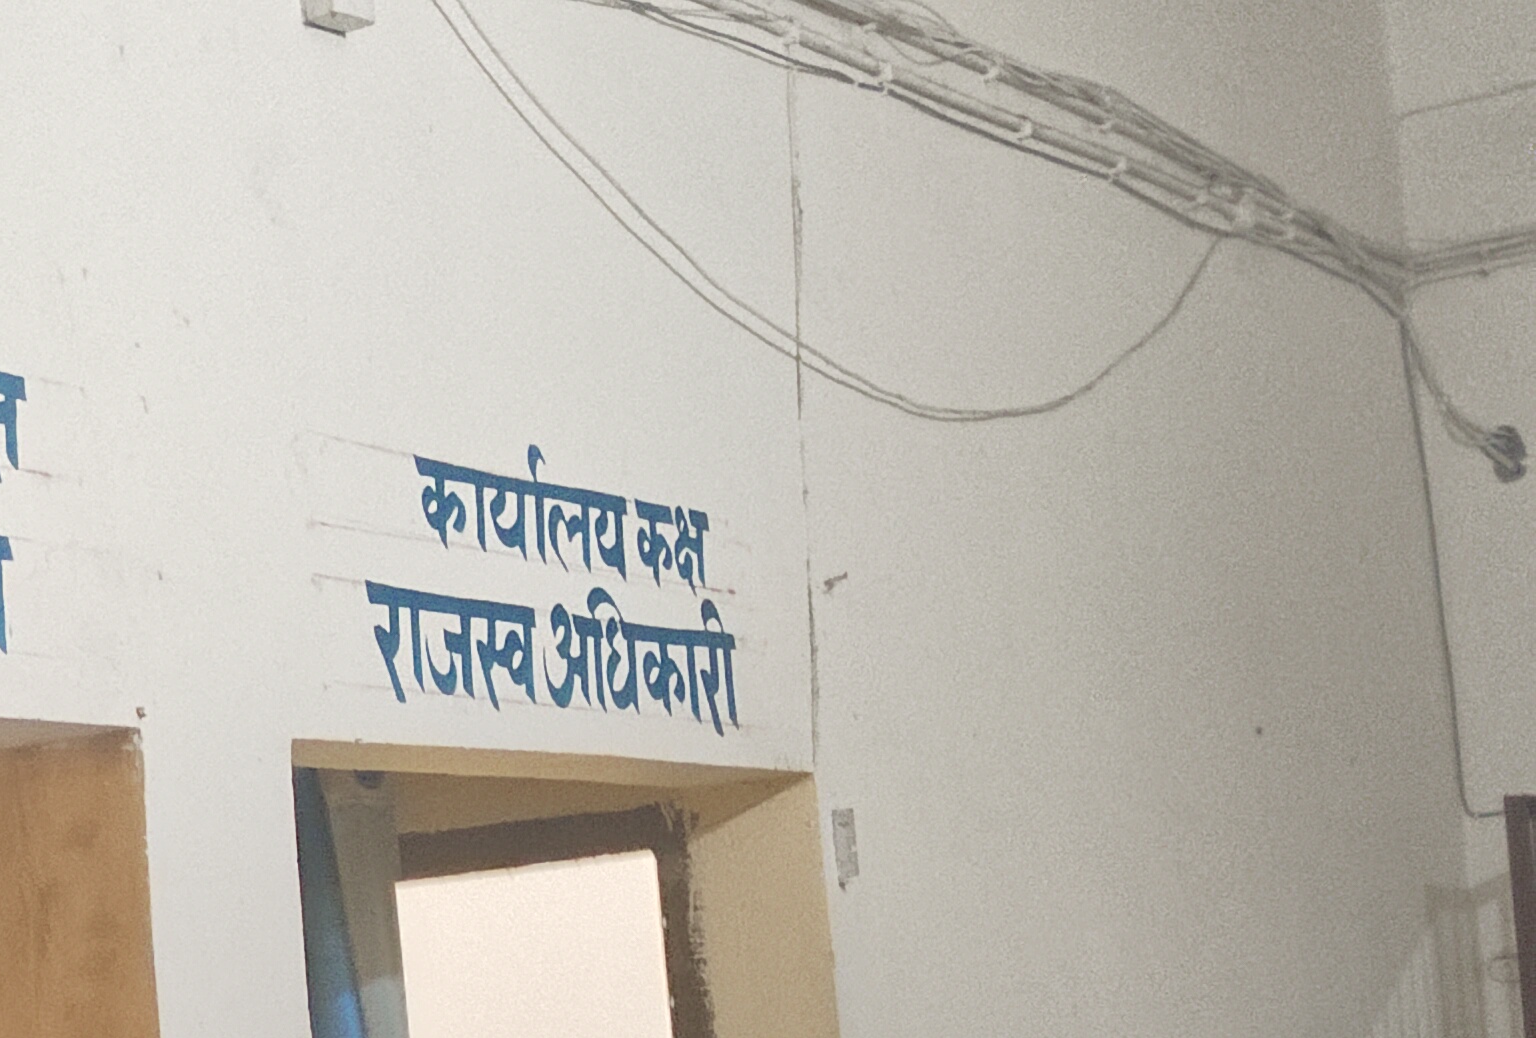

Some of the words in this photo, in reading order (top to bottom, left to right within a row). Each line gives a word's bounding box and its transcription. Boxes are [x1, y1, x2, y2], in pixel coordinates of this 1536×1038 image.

[413, 444, 628, 581] कार्यालय
[634, 498, 709, 597] कक्ष
[365, 579, 537, 711] राजस्व
[543, 587, 739, 737] अधिकारी
